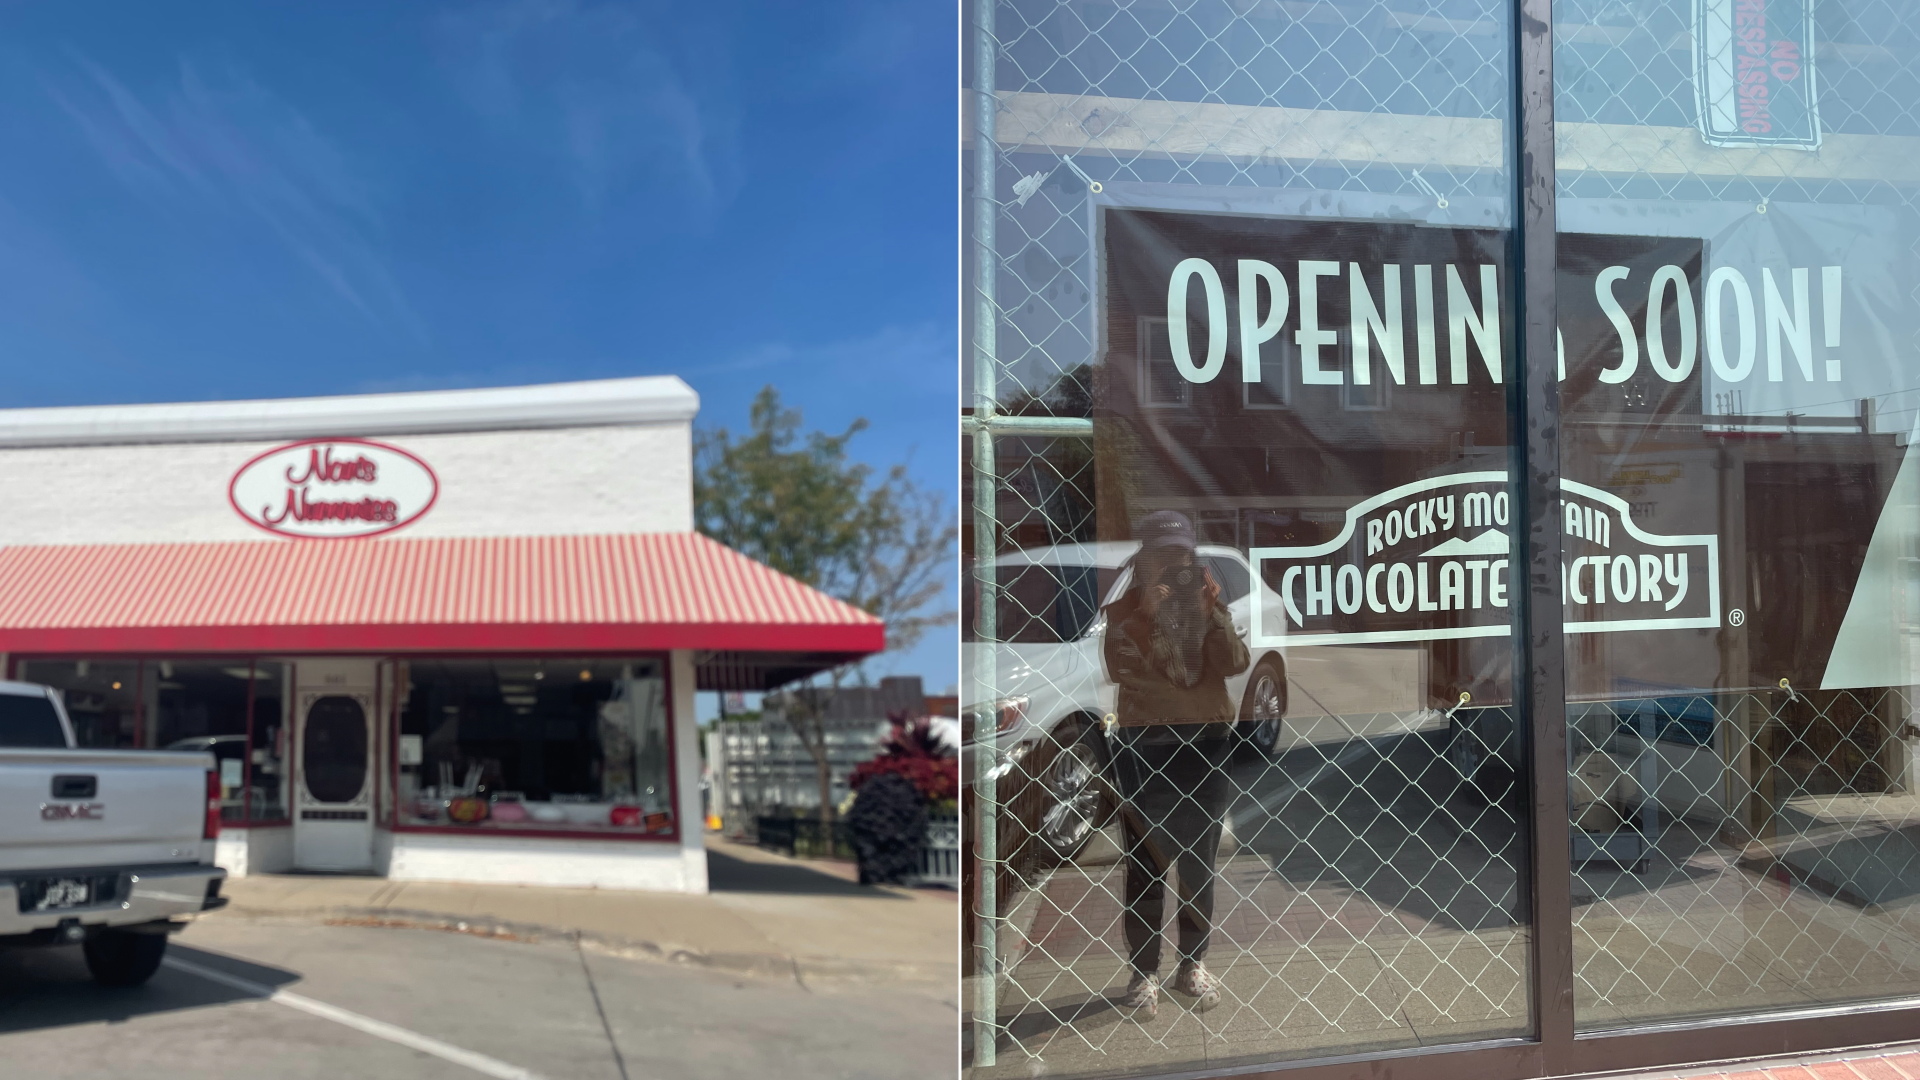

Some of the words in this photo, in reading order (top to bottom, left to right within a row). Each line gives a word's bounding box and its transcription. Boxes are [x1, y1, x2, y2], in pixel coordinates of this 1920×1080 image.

[1770, 40, 1800, 81] NO
[1167, 258, 1566, 385] OPENIN
[1595, 265, 1842, 384] SOON!
[1367, 495, 1455, 557] ROCKY
[1463, 491, 1610, 549] MOAIN
[1281, 559, 1509, 628] CHOCOLATE
[1562, 553, 1689, 612] CTORY
[40, 803, 105, 821] GMC
